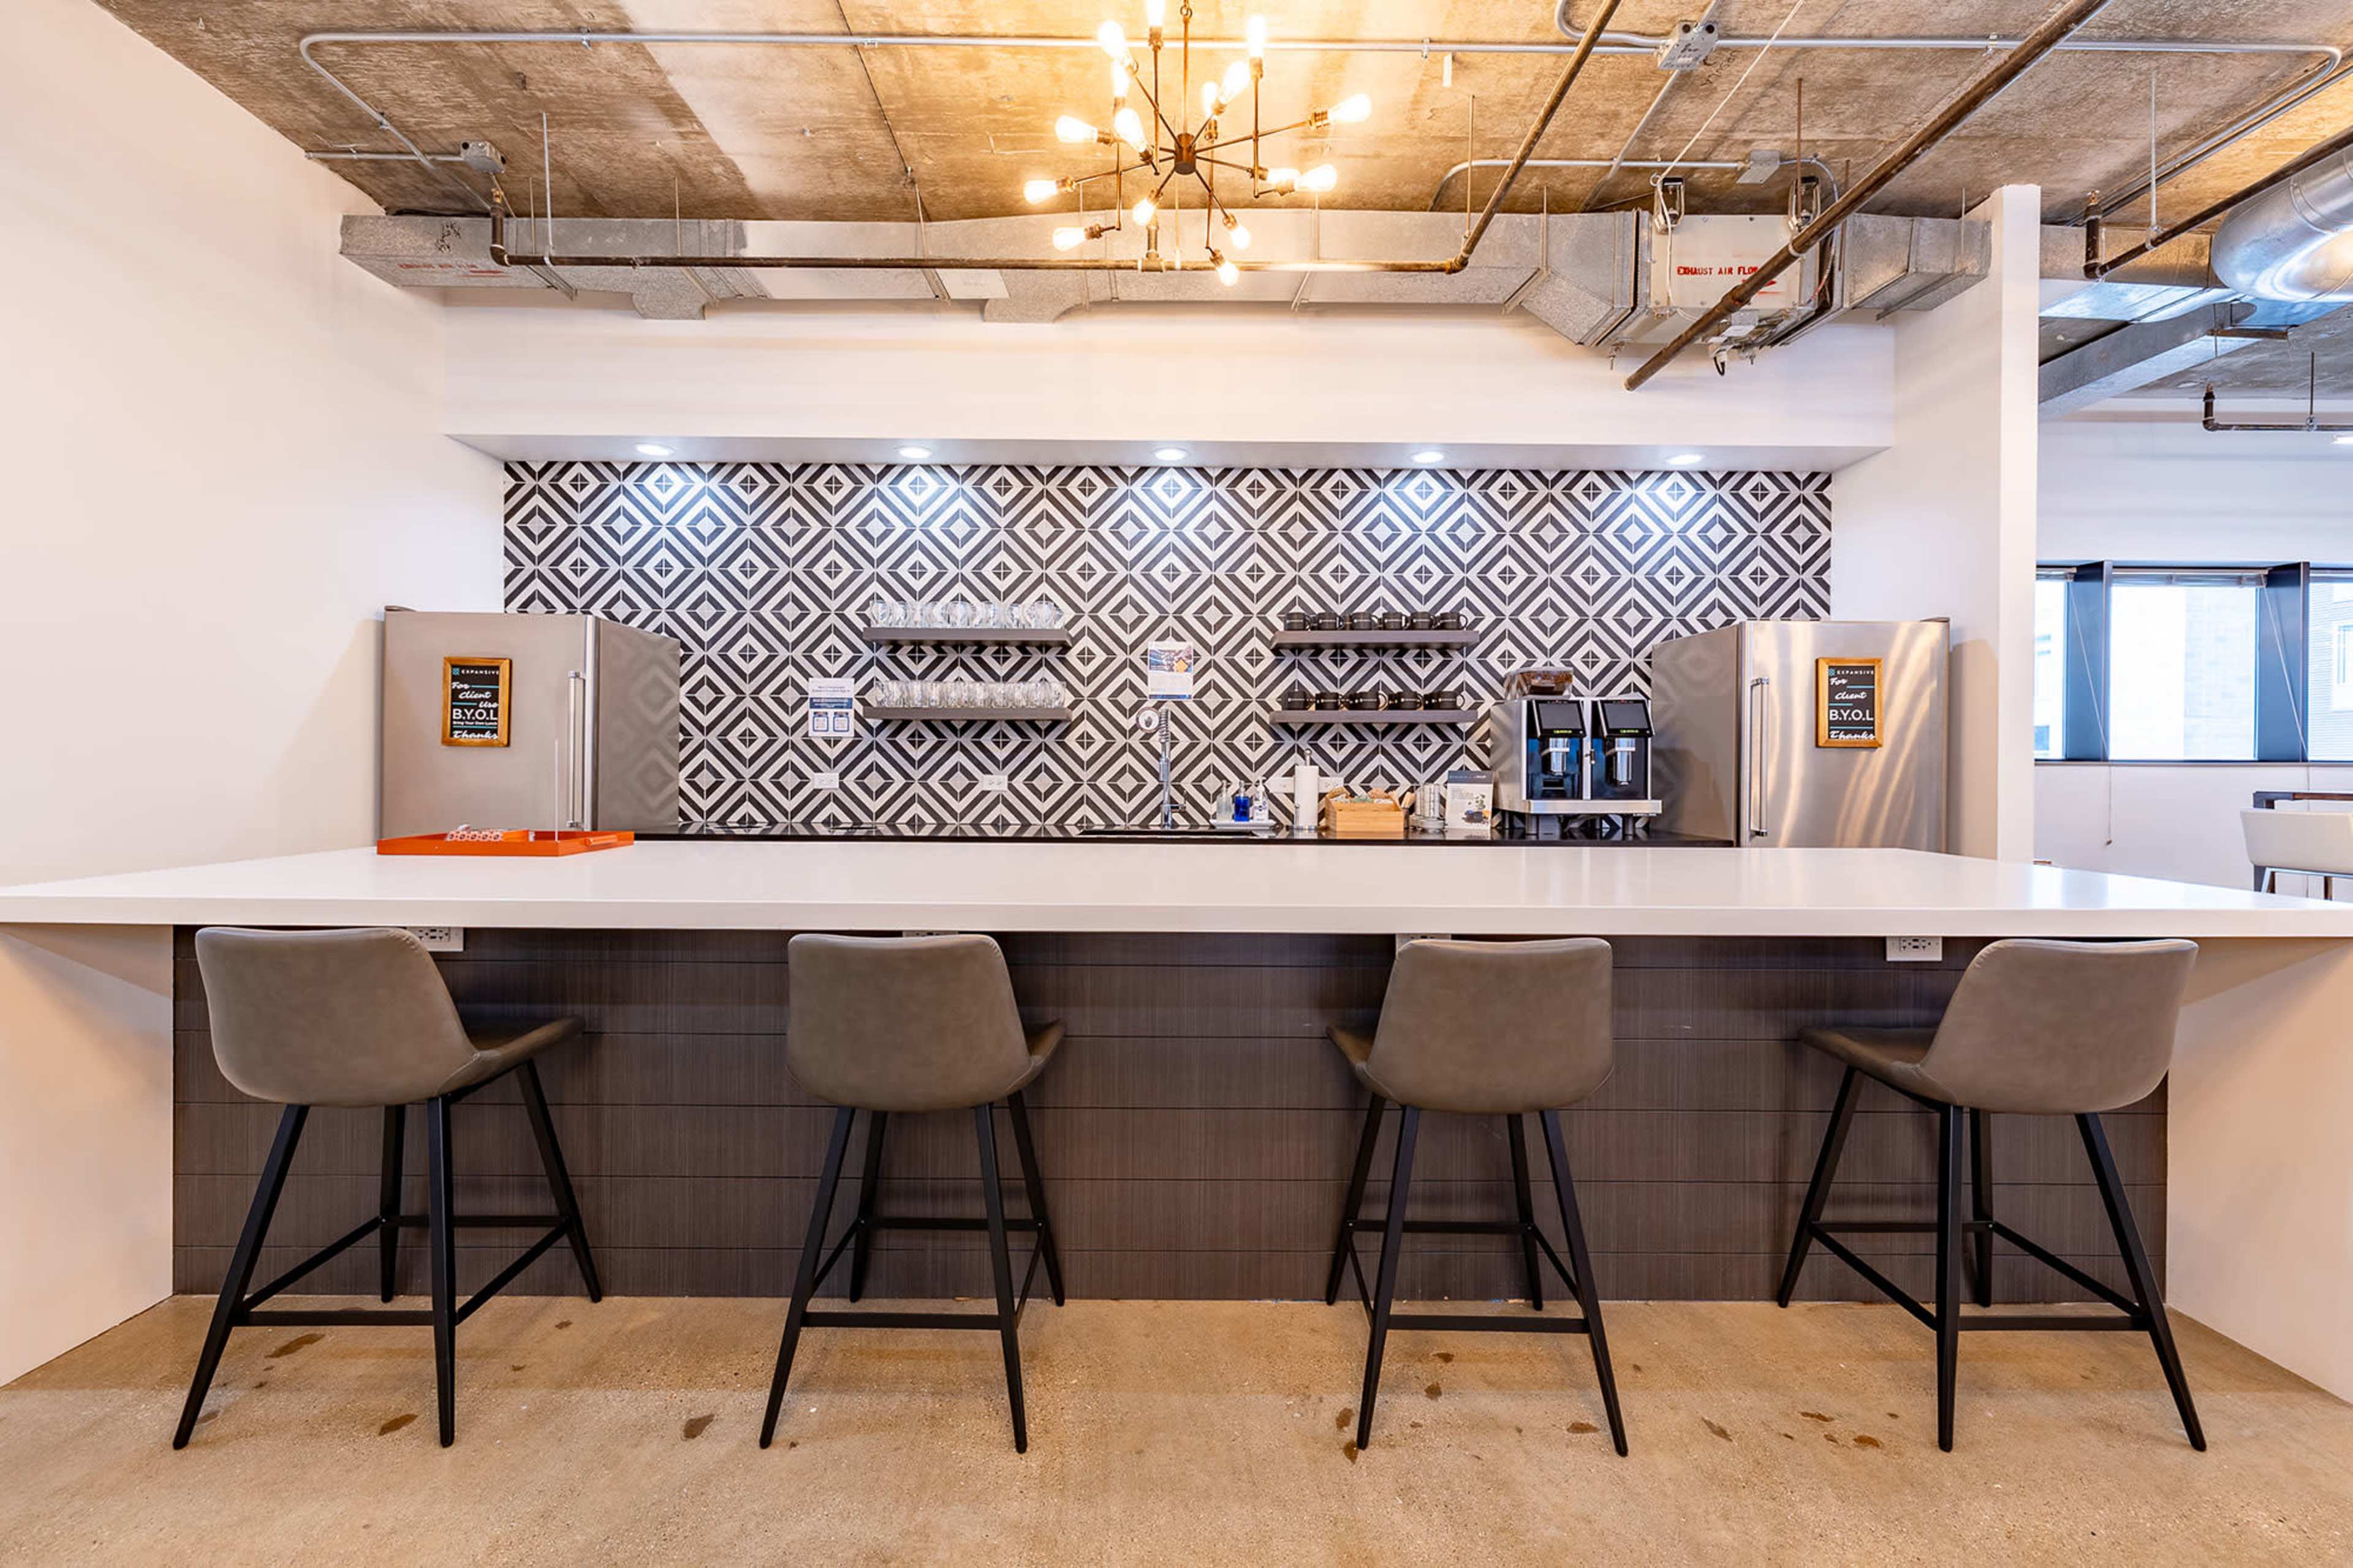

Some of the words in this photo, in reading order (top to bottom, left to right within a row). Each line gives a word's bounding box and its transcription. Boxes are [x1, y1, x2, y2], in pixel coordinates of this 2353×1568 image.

[1677, 266, 1713, 275] EXHAUST
[1718, 267, 1733, 275] AIR
[452, 708, 498, 721] B.Y.O.L
[1829, 709, 1874, 721] B.Y.O.L
[452, 730, 499, 739] Thanks
[1829, 730, 1876, 740] Thanks
